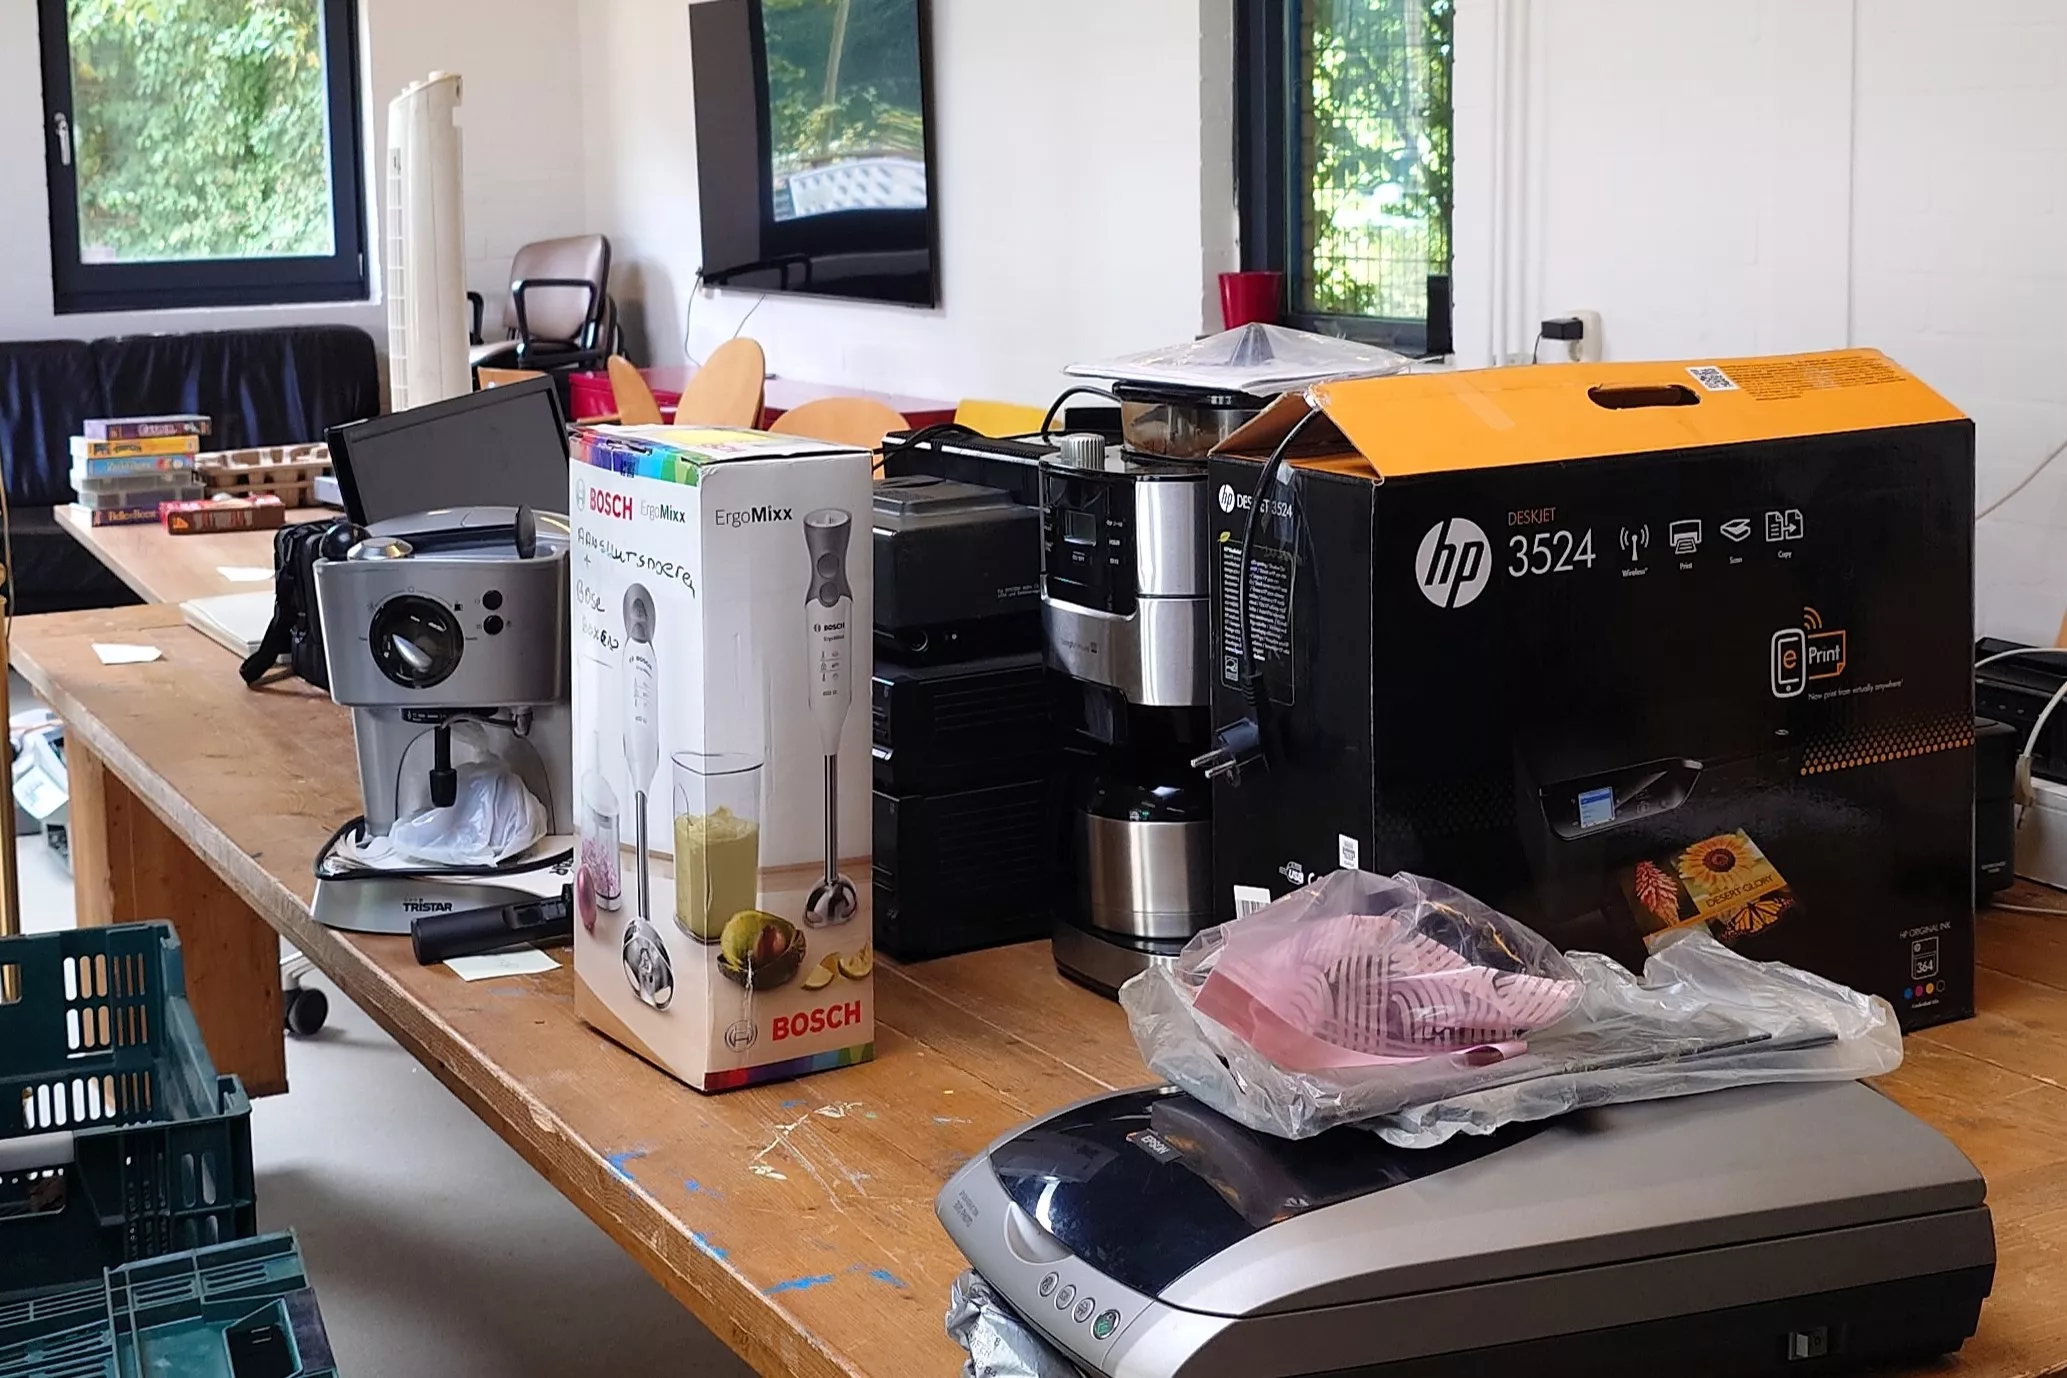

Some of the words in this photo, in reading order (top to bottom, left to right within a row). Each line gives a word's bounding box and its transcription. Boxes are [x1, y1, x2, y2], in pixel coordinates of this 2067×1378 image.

[589, 487, 633, 521] BOSCH
[1219, 484, 1235, 513] hp
[1271, 500, 1293, 519] 3524
[640, 500, 686, 524] ErgoMixx
[715, 504, 793, 528] ErgoMixx
[1507, 506, 1557, 527] DESKJET
[1418, 517, 1489, 609] hp
[1507, 528, 1597, 578] 3524
[1679, 562, 1693, 570] Print
[823, 621, 845, 632] BOSCH
[1706, 887, 1742, 908] DESERT
[1743, 873, 1775, 894] GLORY
[402, 898, 453, 912] TRISTAR
[1916, 959, 1934, 974] 364
[771, 1000, 862, 1042] BOSCH
[1140, 1135, 1169, 1155] EPSON
